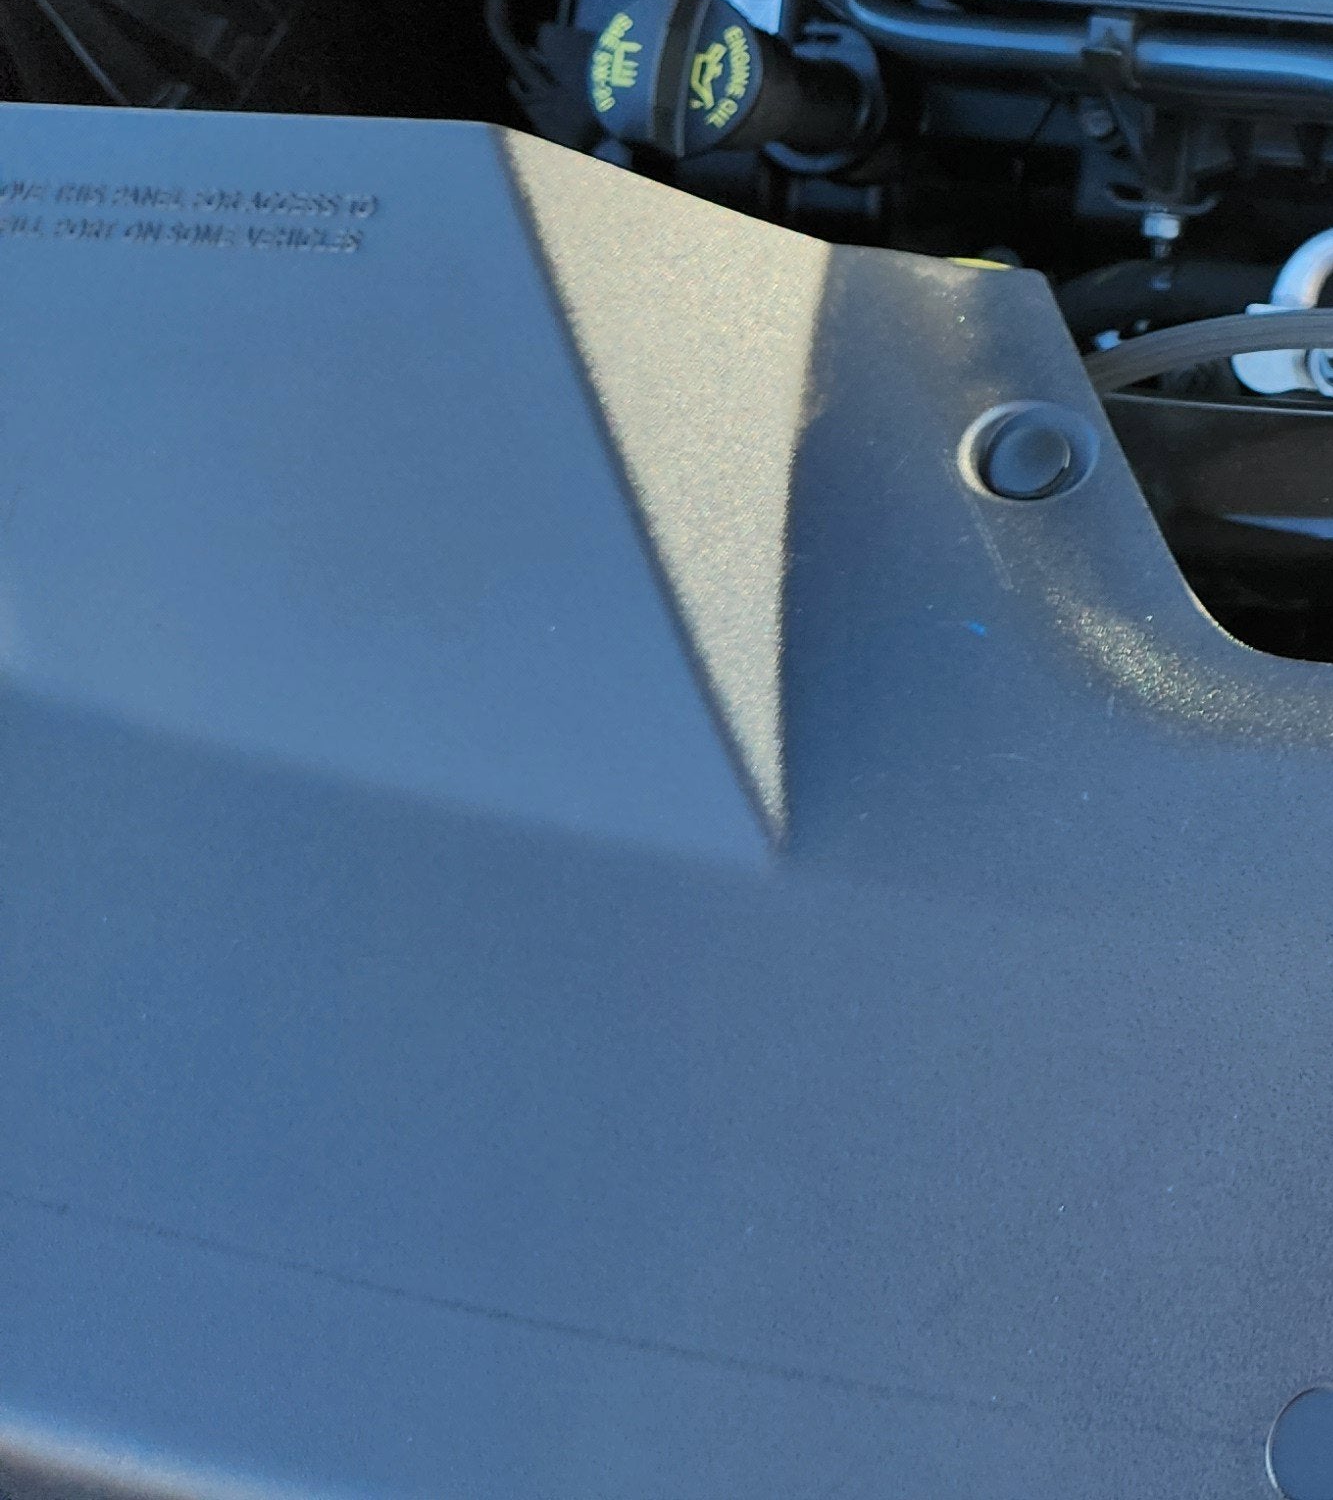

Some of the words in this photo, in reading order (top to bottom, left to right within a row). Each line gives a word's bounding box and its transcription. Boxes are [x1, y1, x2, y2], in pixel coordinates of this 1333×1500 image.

[598, 12, 634, 50] SAE
[722, 25, 751, 98] ENGINE
[704, 98, 739, 129] OIL
